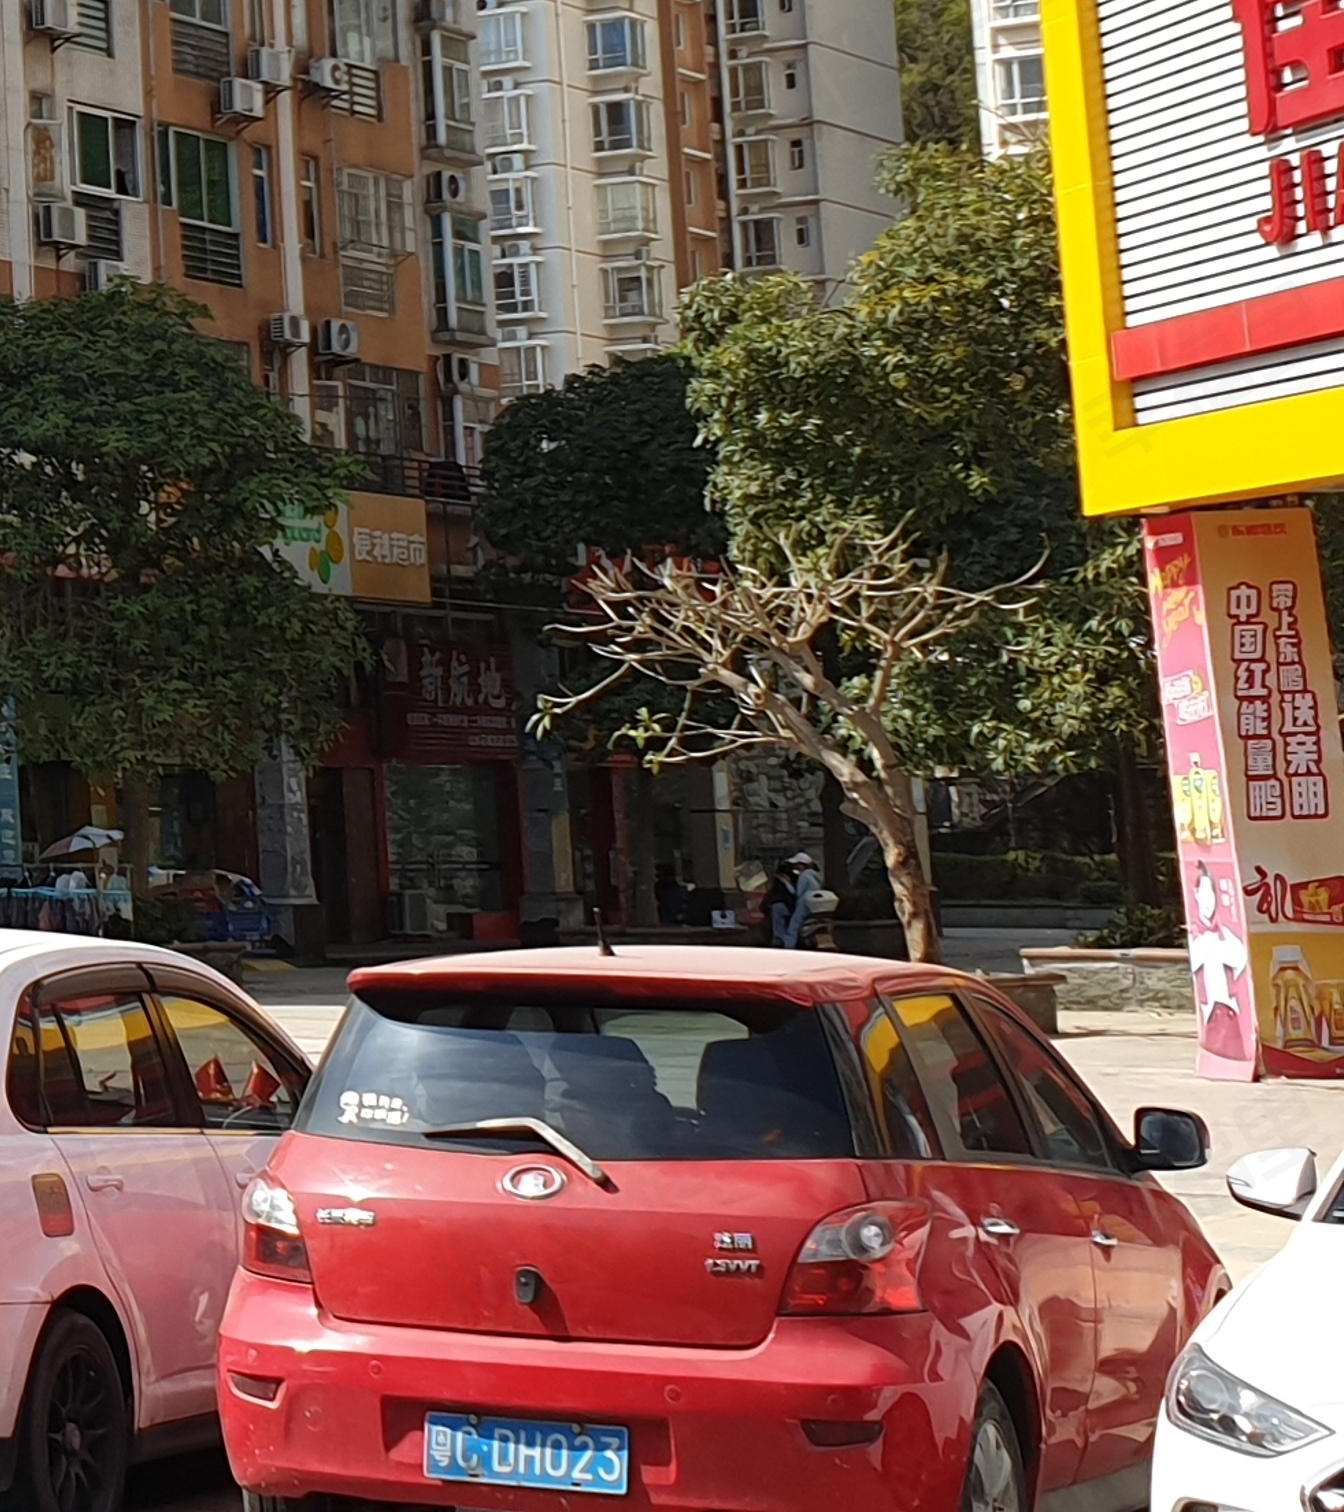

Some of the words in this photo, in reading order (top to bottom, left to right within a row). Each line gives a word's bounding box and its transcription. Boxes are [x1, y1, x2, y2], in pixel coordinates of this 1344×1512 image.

[1257, 139, 1344, 245] JI
[352, 527, 426, 567] 便利超市
[1229, 584, 1282, 818] 中国红能量鹏
[1272, 582, 1326, 817] 带上东鹏送亲朋
